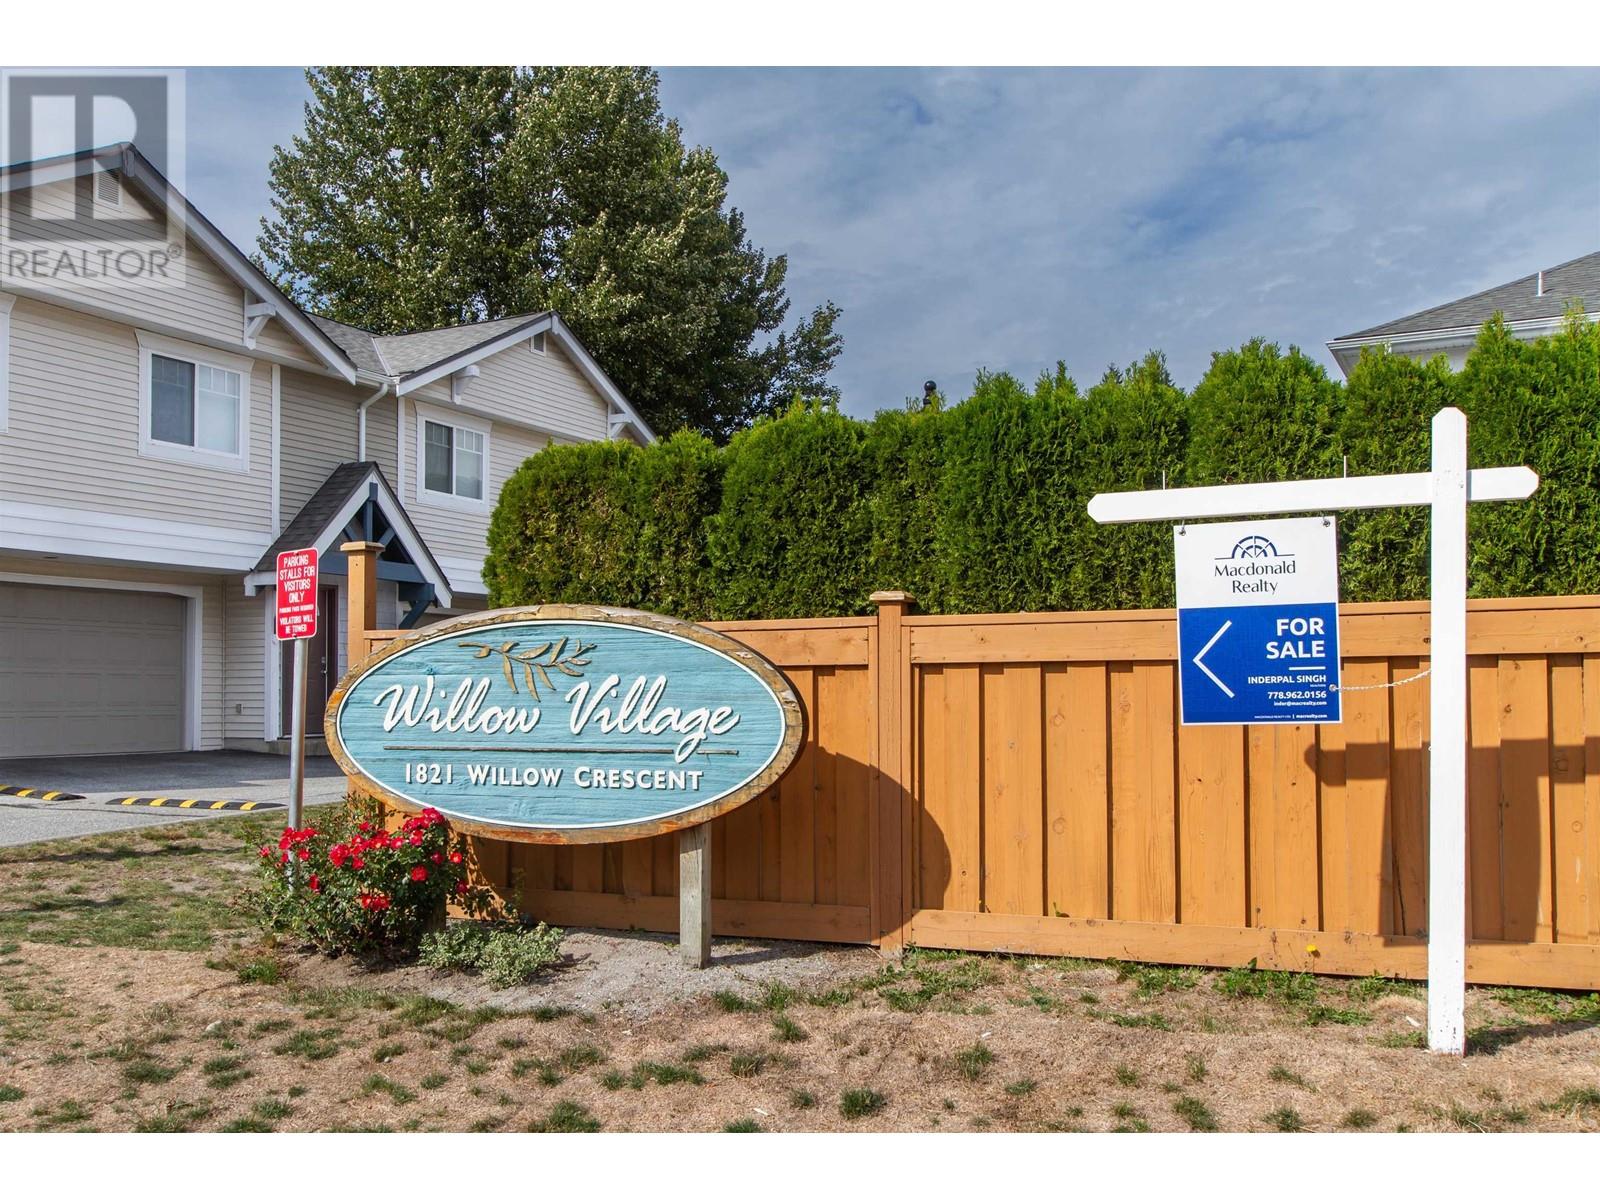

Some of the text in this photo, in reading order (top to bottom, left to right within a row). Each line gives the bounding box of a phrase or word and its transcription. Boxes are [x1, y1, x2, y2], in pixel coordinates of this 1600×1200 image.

[284, 555, 309, 568] PARKING
[1214, 560, 1296, 577] Macdonald
[280, 565, 316, 580] STALLS FOR
[284, 579, 311, 592] VISITORS
[1232, 579, 1278, 595] Realty
[289, 592, 305, 603] ONLY
[1276, 617, 1325, 636] FOR
[1266, 640, 1326, 659] SALE
[1247, 674, 1327, 684] INDERPAL SINGH
[1267, 690, 1327, 700] 778.962.0156
[373, 674, 741, 764] Willow Village
[404, 763, 453, 786] 1821
